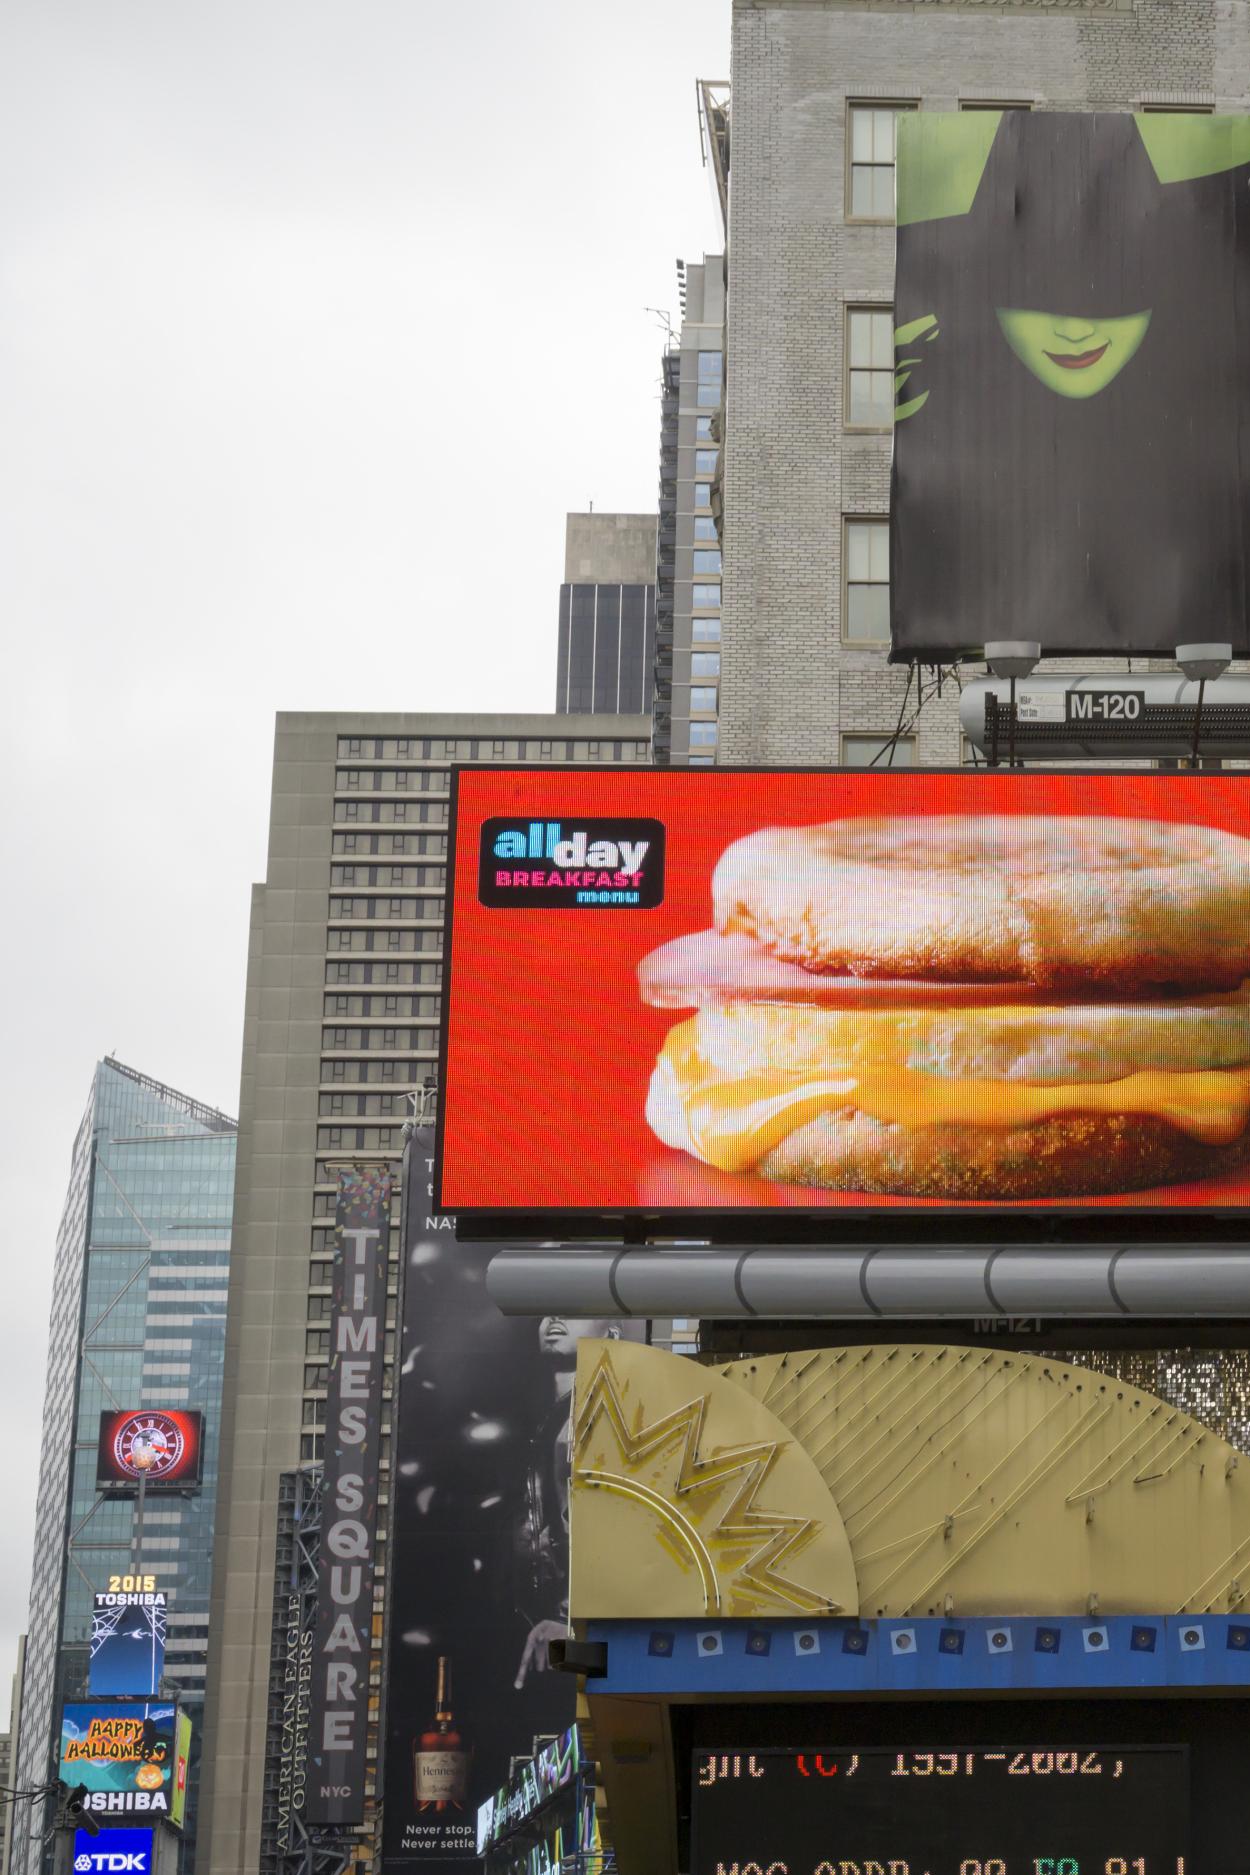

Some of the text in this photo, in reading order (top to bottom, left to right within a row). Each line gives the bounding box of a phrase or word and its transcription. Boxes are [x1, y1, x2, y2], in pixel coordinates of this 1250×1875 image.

[1070, 693, 1140, 720] M-120
[495, 870, 644, 888] BREAKFAST
[576, 890, 641, 904] menu
[336, 1228, 381, 1445] TIMES
[109, 1576, 156, 1592] 2015
[95, 1592, 166, 1606] TOSHIBA
[322, 1472, 370, 1751] SQUARE
[275, 1593, 302, 1851] AMERICAN EAGLE
[292, 1629, 315, 1811] OUTFITTERS
[90, 1721, 143, 1739] HAPPY
[320, 1785, 352, 1798] NYC
[406, 1825, 476, 1836] Never stop.
[401, 1838, 437, 1849] Never
[91, 1852, 147, 1871] TDK
